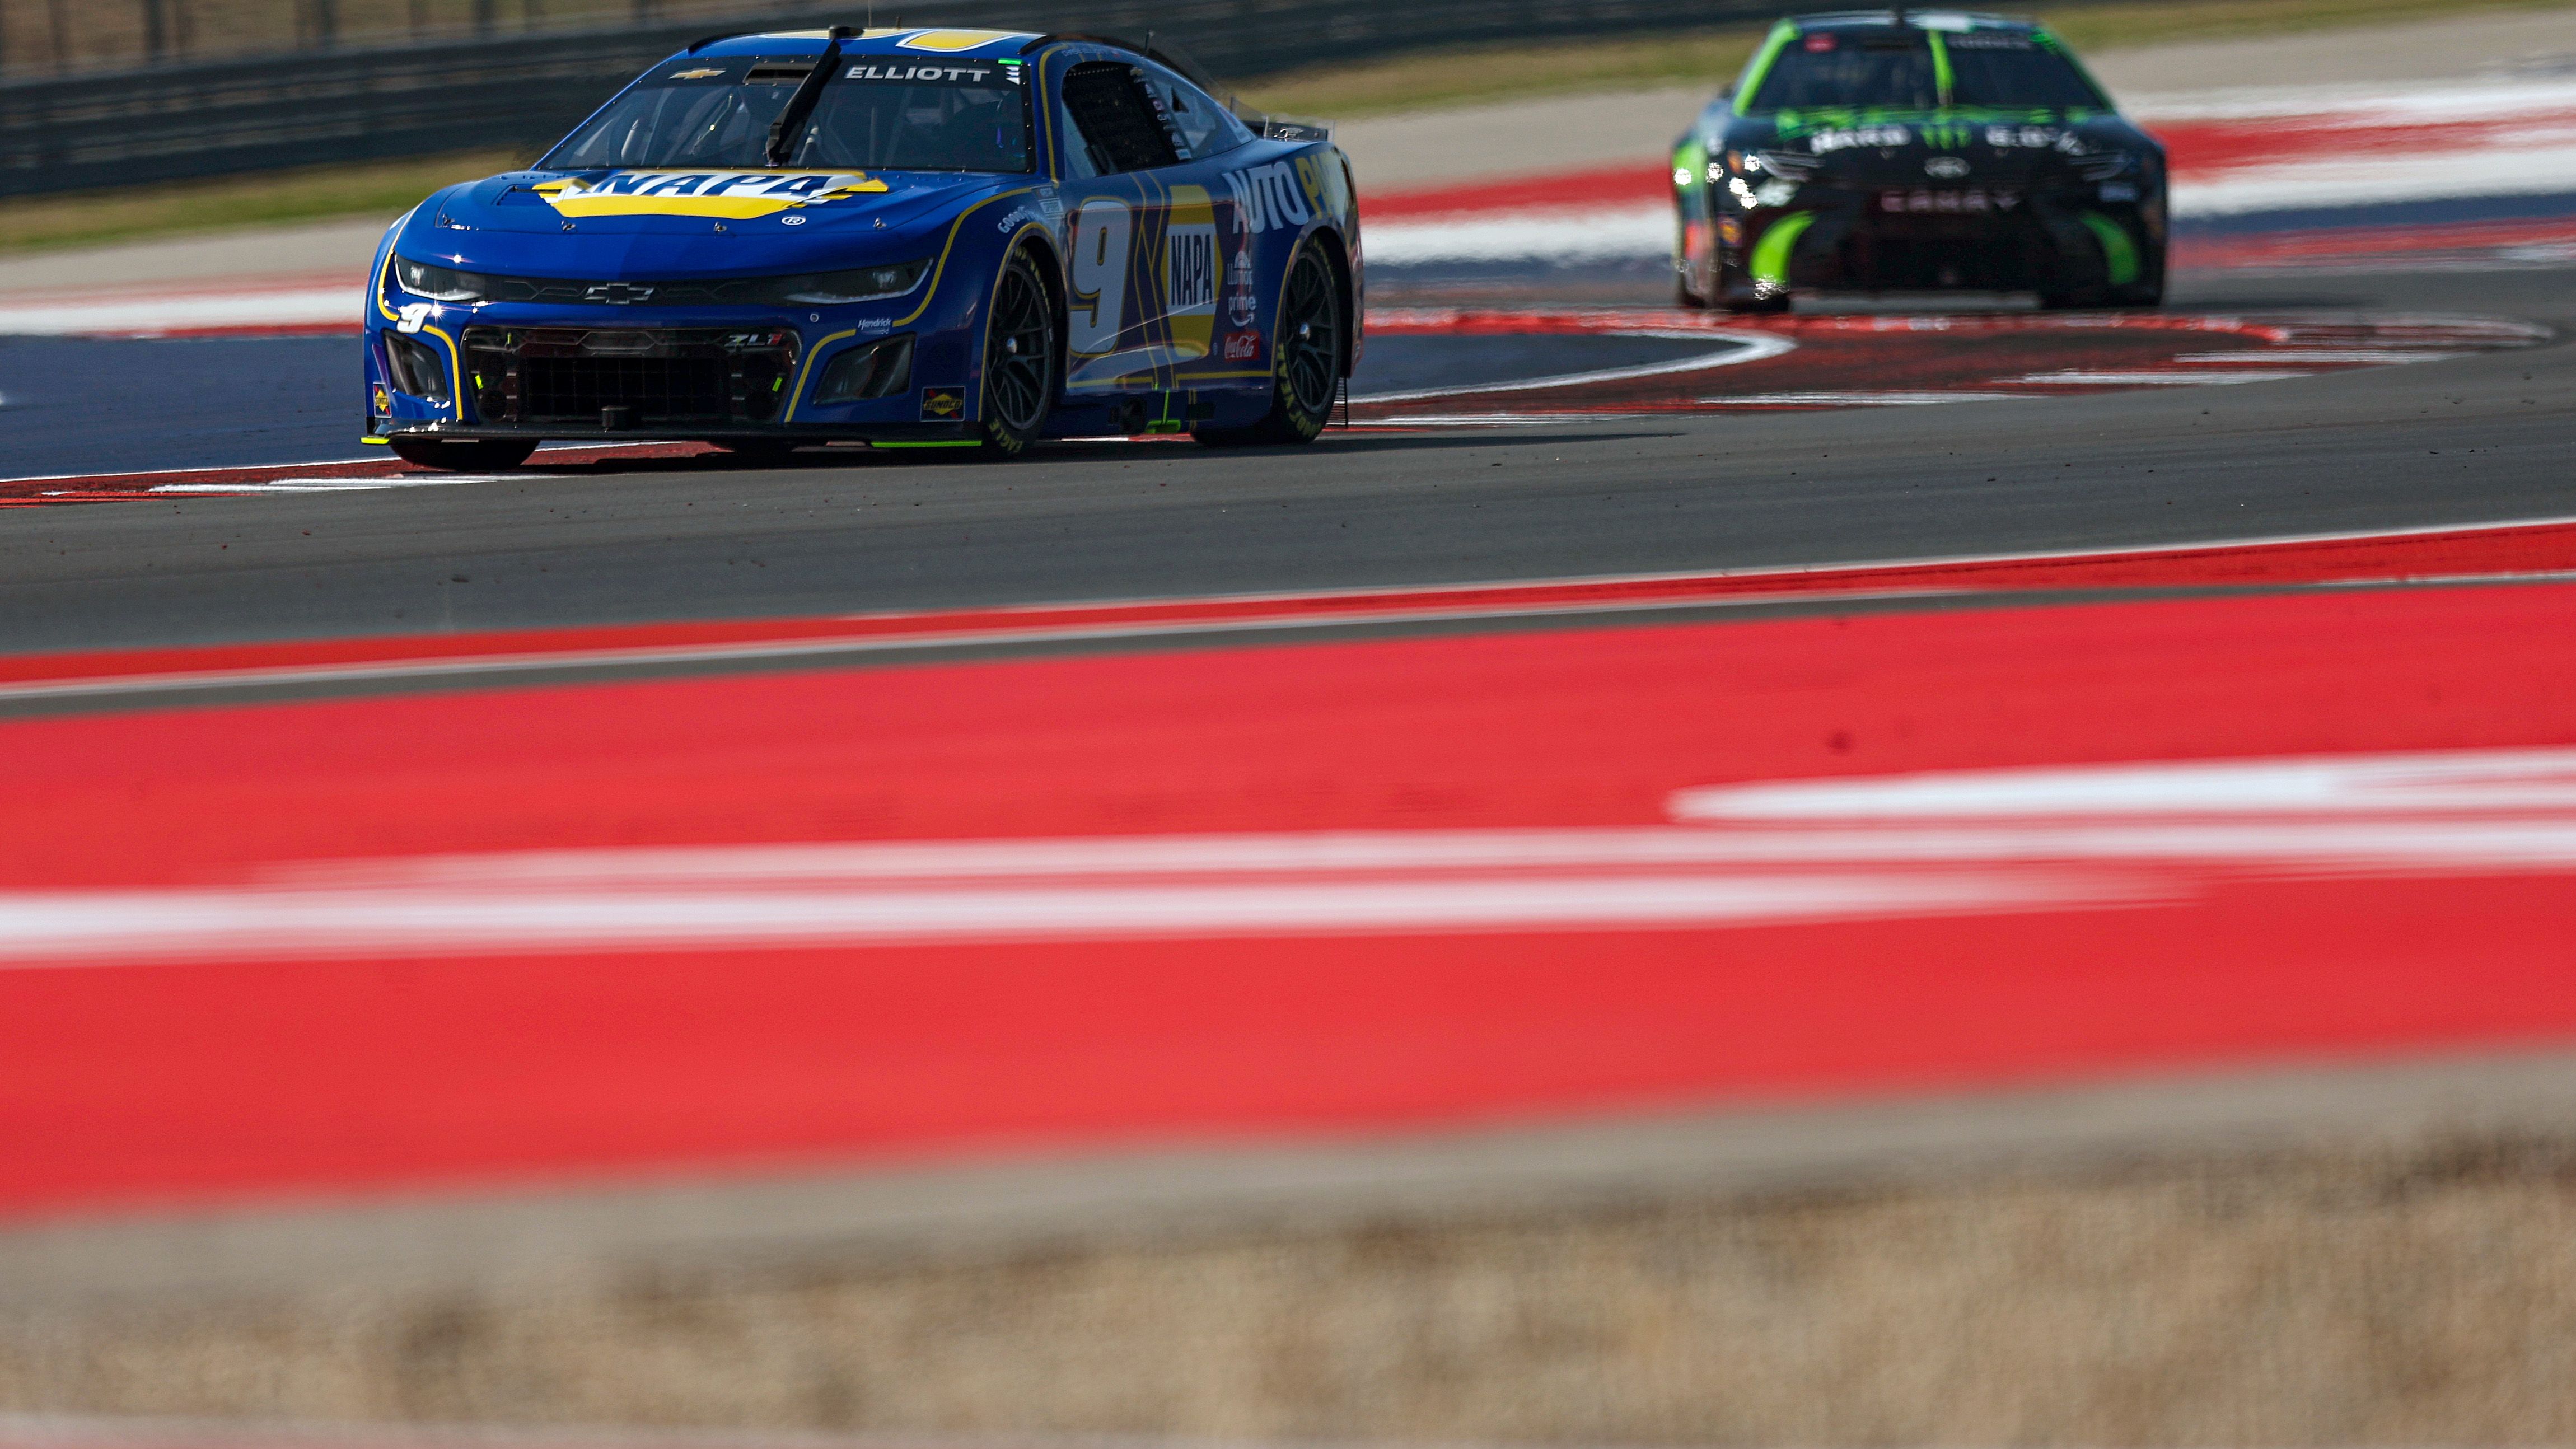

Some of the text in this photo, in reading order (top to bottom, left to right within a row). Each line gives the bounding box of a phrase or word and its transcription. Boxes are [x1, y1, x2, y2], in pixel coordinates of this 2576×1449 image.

[845, 64, 990, 82] ELLIOTT
[577, 174, 832, 197] NAPA
[1221, 161, 1309, 234] AUTO
[1068, 197, 1133, 357] 9
[1171, 234, 1213, 306] NAPA
[1228, 292, 1257, 315] prime
[396, 303, 432, 334] 9
[858, 317, 891, 330] Hendrick
[724, 334, 782, 347] ZL1
[924, 399, 963, 410] SUNOCO
